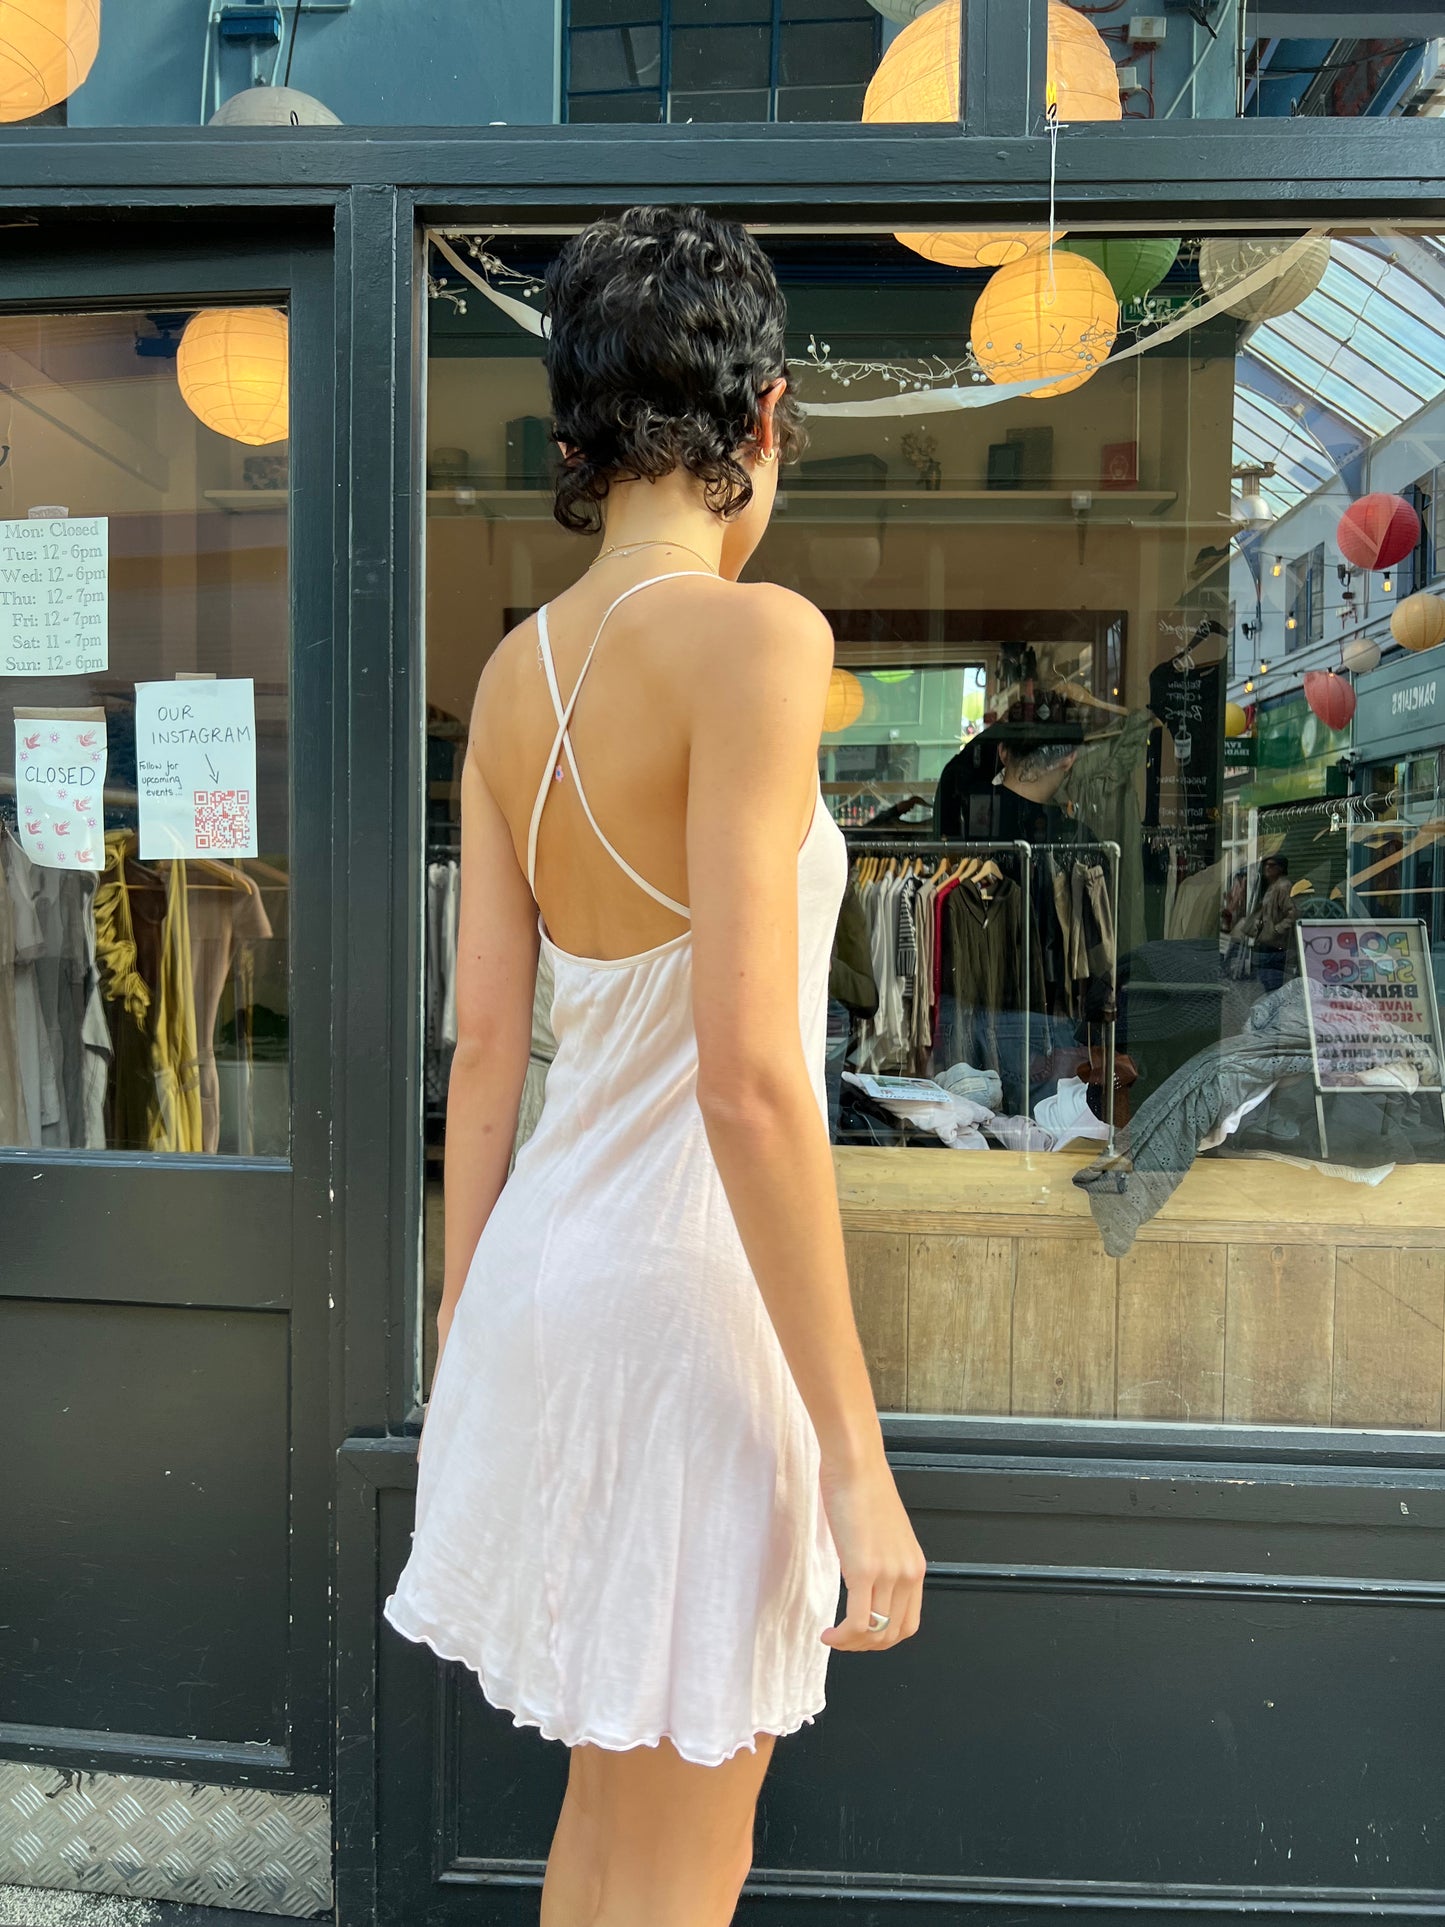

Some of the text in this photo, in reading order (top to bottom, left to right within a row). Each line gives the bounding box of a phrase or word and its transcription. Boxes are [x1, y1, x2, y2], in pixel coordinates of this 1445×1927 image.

[5, 521, 99, 539] Mon: Closed
[3, 547, 38, 561] Tue:
[0, 568, 43, 583] Wed:
[0, 591, 36, 606] Thu:
[12, 613, 39, 627] Fri:
[12, 635, 41, 649] Sat:
[6, 656, 41, 671] Sun:
[157, 704, 194, 722] OUR
[151, 725, 251, 745] INSTAGRAM
[139, 760, 179, 776] Follow for
[25, 766, 96, 786] CLOSED
[141, 775, 183, 790] upcoming
